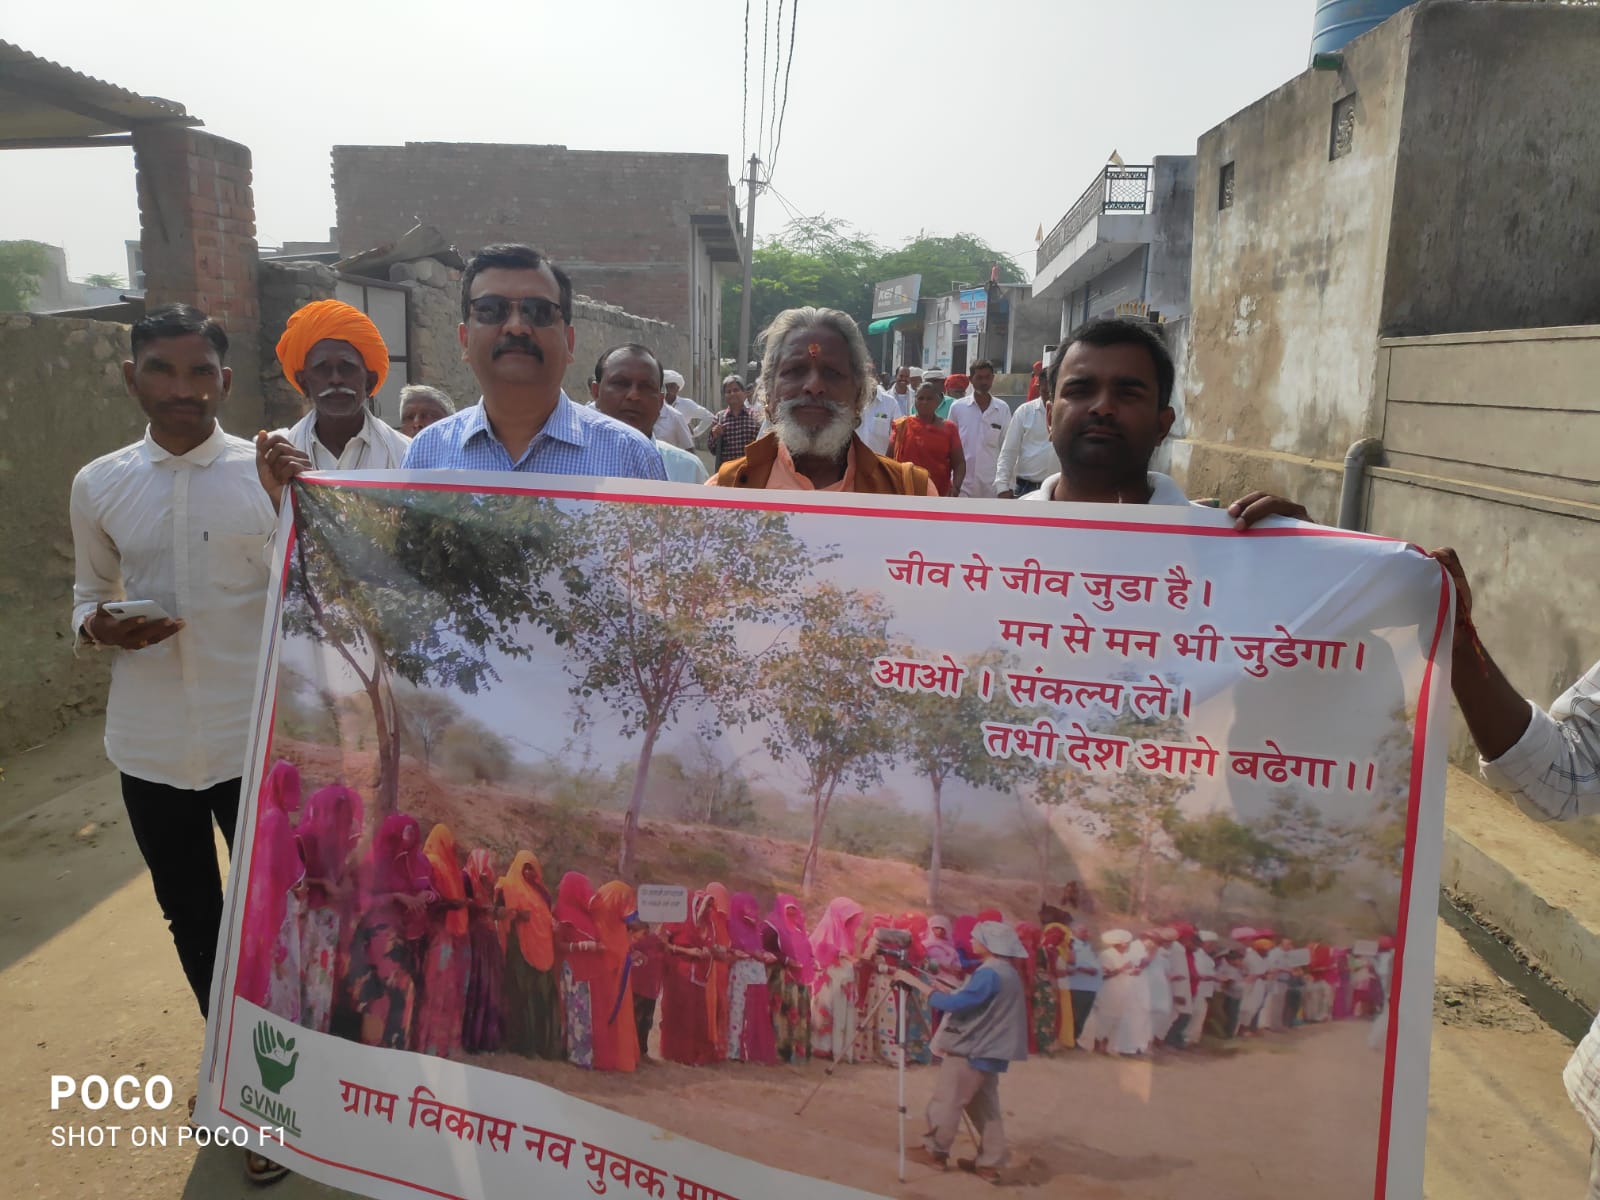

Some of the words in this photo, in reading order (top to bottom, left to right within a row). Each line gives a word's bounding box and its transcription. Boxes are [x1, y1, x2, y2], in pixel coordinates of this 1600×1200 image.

[885, 549, 955, 588] जीव
[960, 552, 993, 592] से
[999, 557, 1075, 597] जीव
[1080, 571, 1159, 612] जुडा
[998, 618, 1054, 649] मन
[1060, 612, 1096, 654] से
[1103, 627, 1161, 659] मन
[1173, 624, 1224, 663] भी
[874, 654, 965, 694] आओ
[1006, 665, 1125, 711] संकल्प
[985, 720, 1060, 760] तभी
[1065, 722, 1130, 772] देश
[1136, 735, 1221, 778] आगे
[240, 1084, 302, 1134] GVNML
[339, 1079, 399, 1123] ग्राम
[408, 1085, 517, 1153] विकास
[523, 1125, 577, 1170] नव
[582, 1141, 668, 1196] युवक
